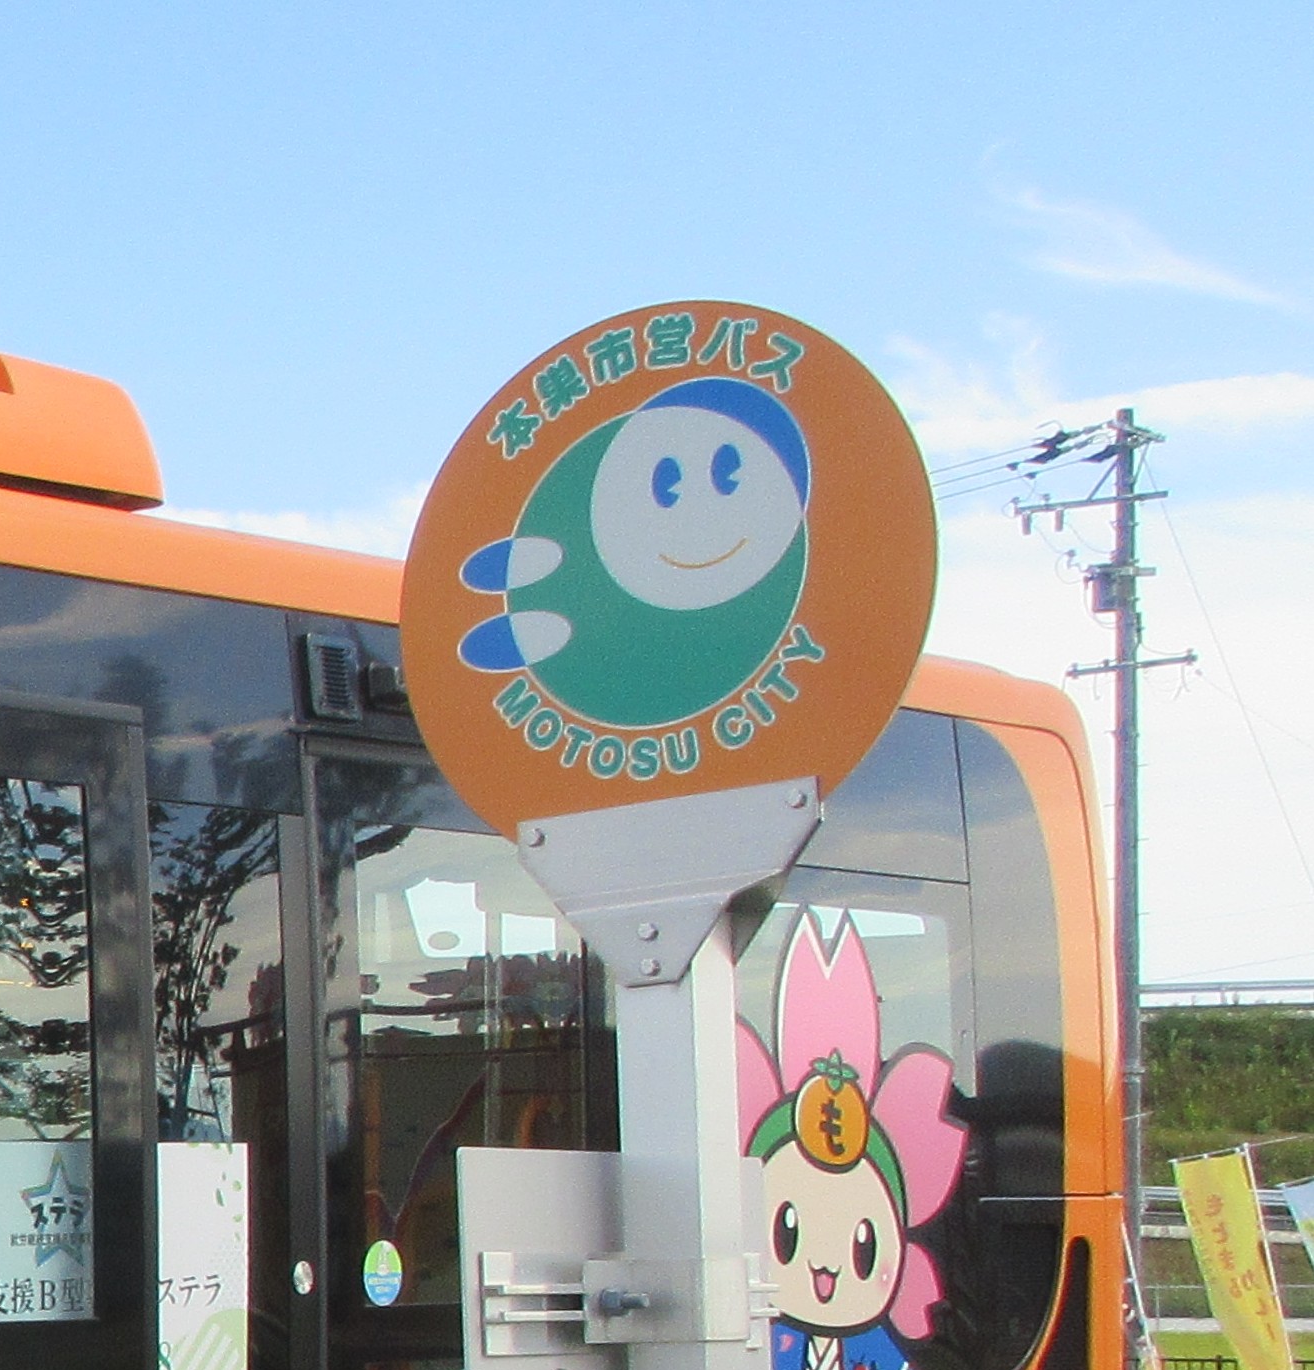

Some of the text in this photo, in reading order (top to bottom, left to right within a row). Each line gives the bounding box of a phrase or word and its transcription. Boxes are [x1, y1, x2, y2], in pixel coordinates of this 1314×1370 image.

[488, 313, 805, 459] 本巣市営バス
[492, 624, 826, 782] MOTOSU CITY
[817, 1097, 847, 1157] も
[29, 1196, 86, 1231] ステラ
